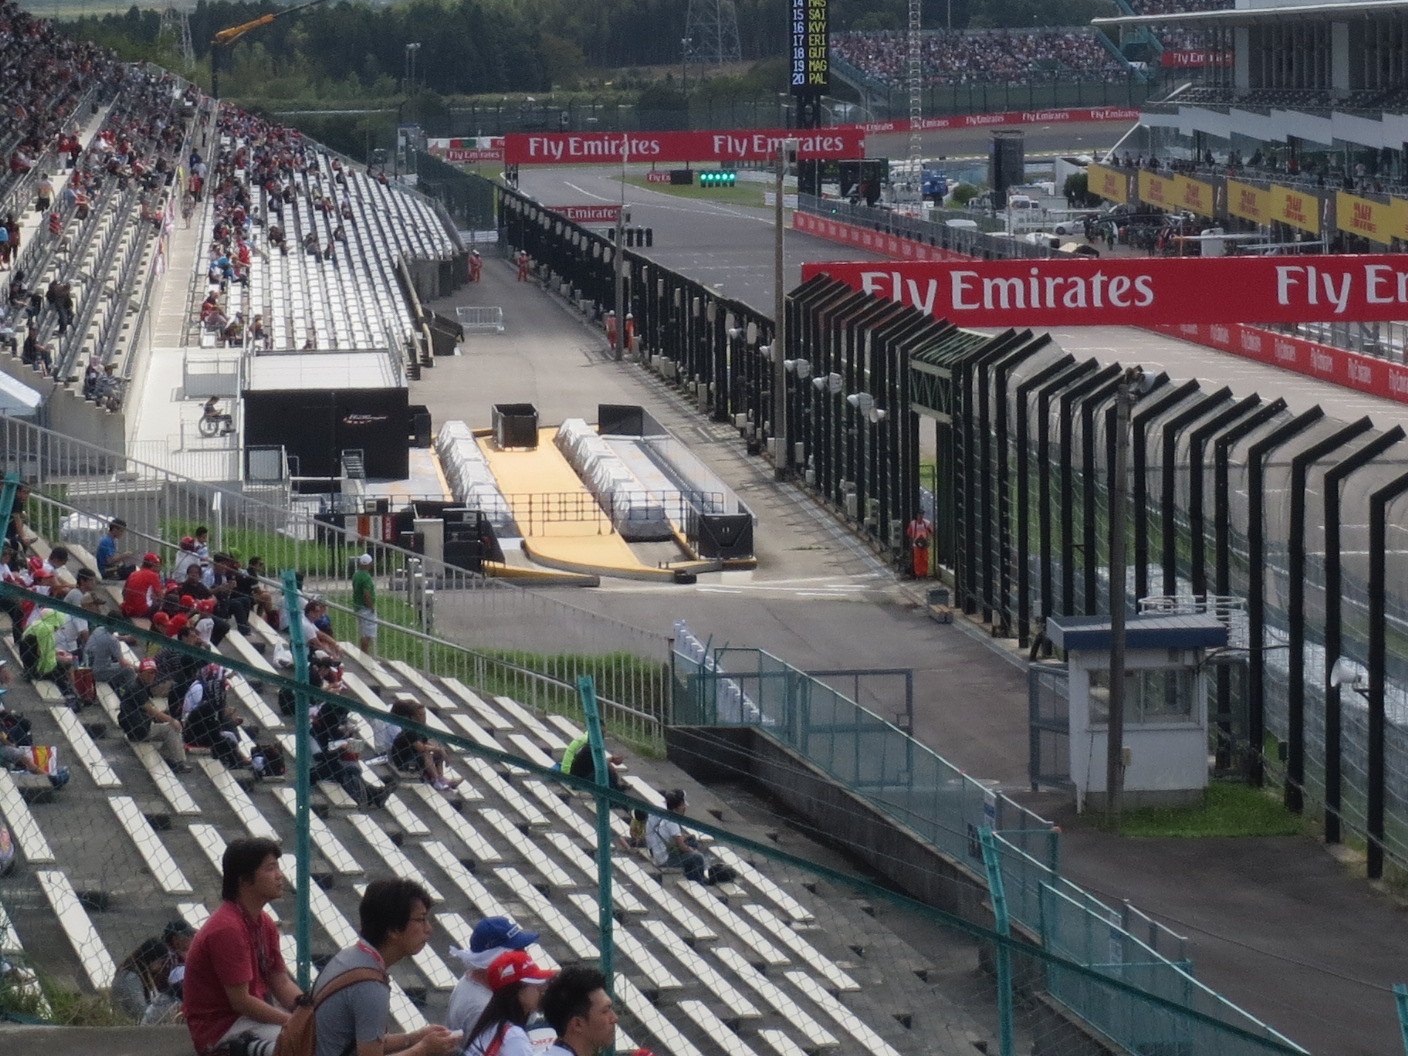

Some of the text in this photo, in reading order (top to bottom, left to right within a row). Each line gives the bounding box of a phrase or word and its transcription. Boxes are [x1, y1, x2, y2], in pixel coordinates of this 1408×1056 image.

[793, 8, 826, 20] 15 SAI
[793, 21, 827, 34] 16 KVY
[793, 34, 826, 46] 17 ERI
[794, 46, 827, 59] 18 GUT
[794, 59, 828, 72] 19 MAG
[792, 72, 828, 85] 20 PAL
[529, 136, 661, 159] Fly Emirates
[713, 133, 844, 157] Fly Emrates
[464, 150, 500, 159] Emrates
[860, 267, 1154, 316] Fly Emirates
[1275, 265, 1352, 313] Fly
